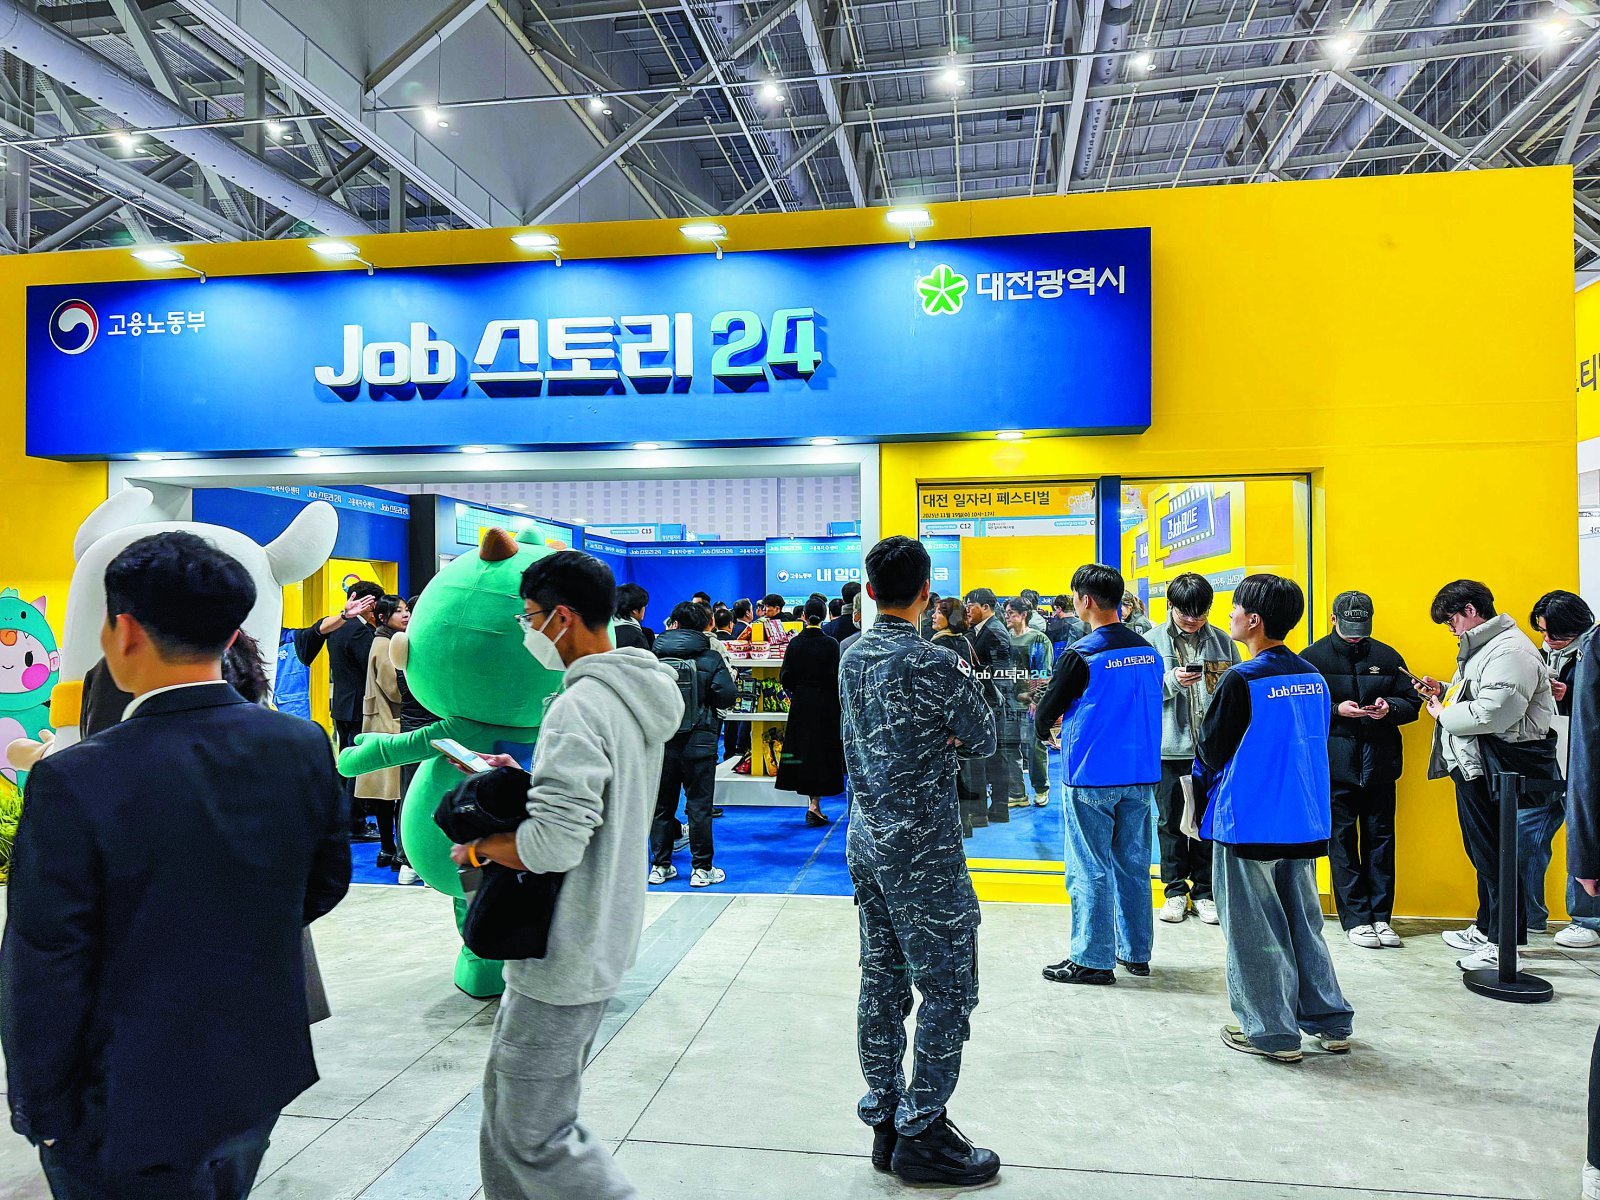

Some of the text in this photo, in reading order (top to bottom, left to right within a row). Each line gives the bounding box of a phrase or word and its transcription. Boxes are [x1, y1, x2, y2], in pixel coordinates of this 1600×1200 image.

[976, 265, 1125, 301] 대전광역시
[107, 310, 206, 337] 고용노동부
[314, 307, 823, 387] Job 스토리 24
[922, 490, 1050, 508] 대전 일자리 페스티벌
[816, 568, 831, 582] 내
[1104, 658, 1123, 669] Job
[993, 669, 1029, 680] 스토리
[1267, 685, 1290, 699] Job
